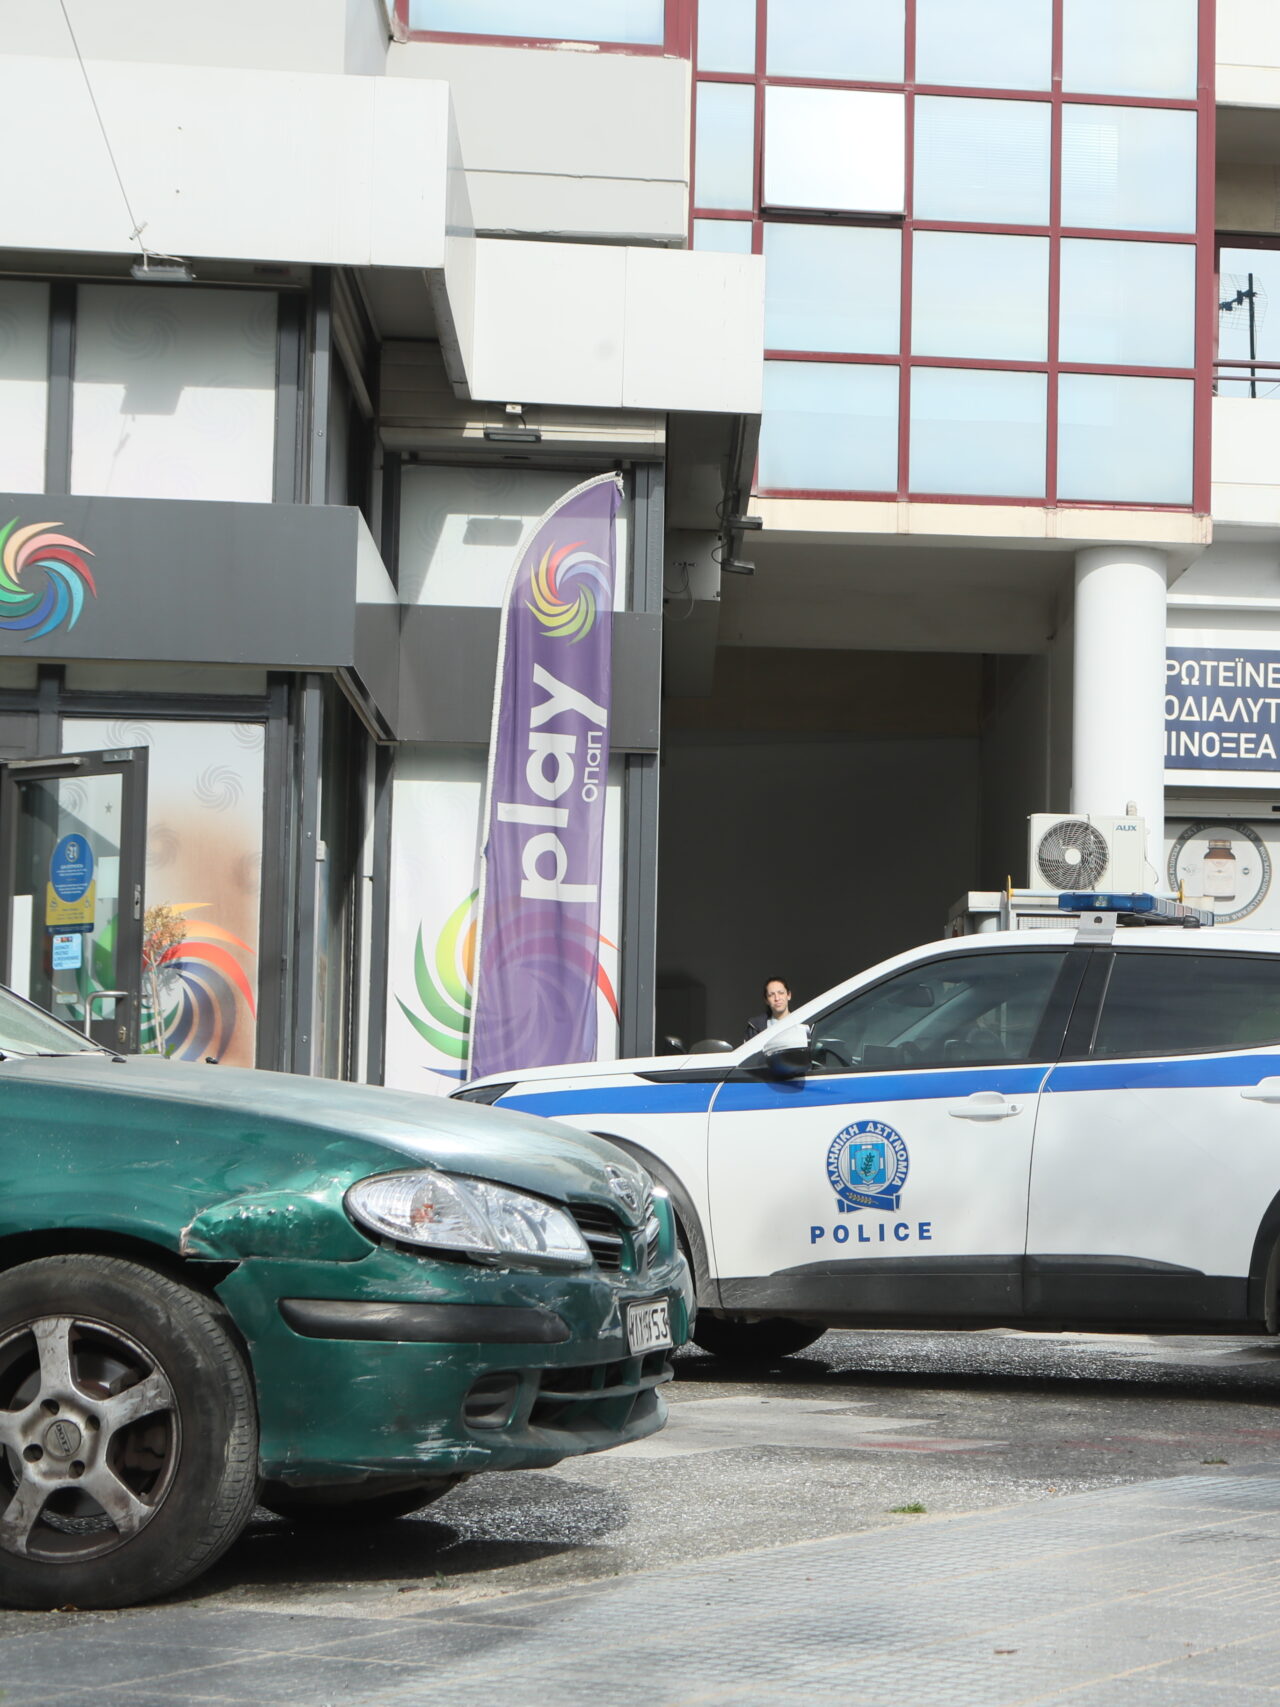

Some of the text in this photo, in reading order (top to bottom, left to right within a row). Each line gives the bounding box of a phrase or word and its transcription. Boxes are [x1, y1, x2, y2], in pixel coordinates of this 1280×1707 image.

[1164, 730, 1277, 760] ΙΝΟΞΕΑ
[497, 663, 608, 903] play
[1116, 824, 1137, 832] AUX
[828, 1122, 906, 1191] ΕΛΛΗΝΙΚΗ ΑΣΤΥΝΟΜΙΑ
[810, 1222, 932, 1244] POLICE
